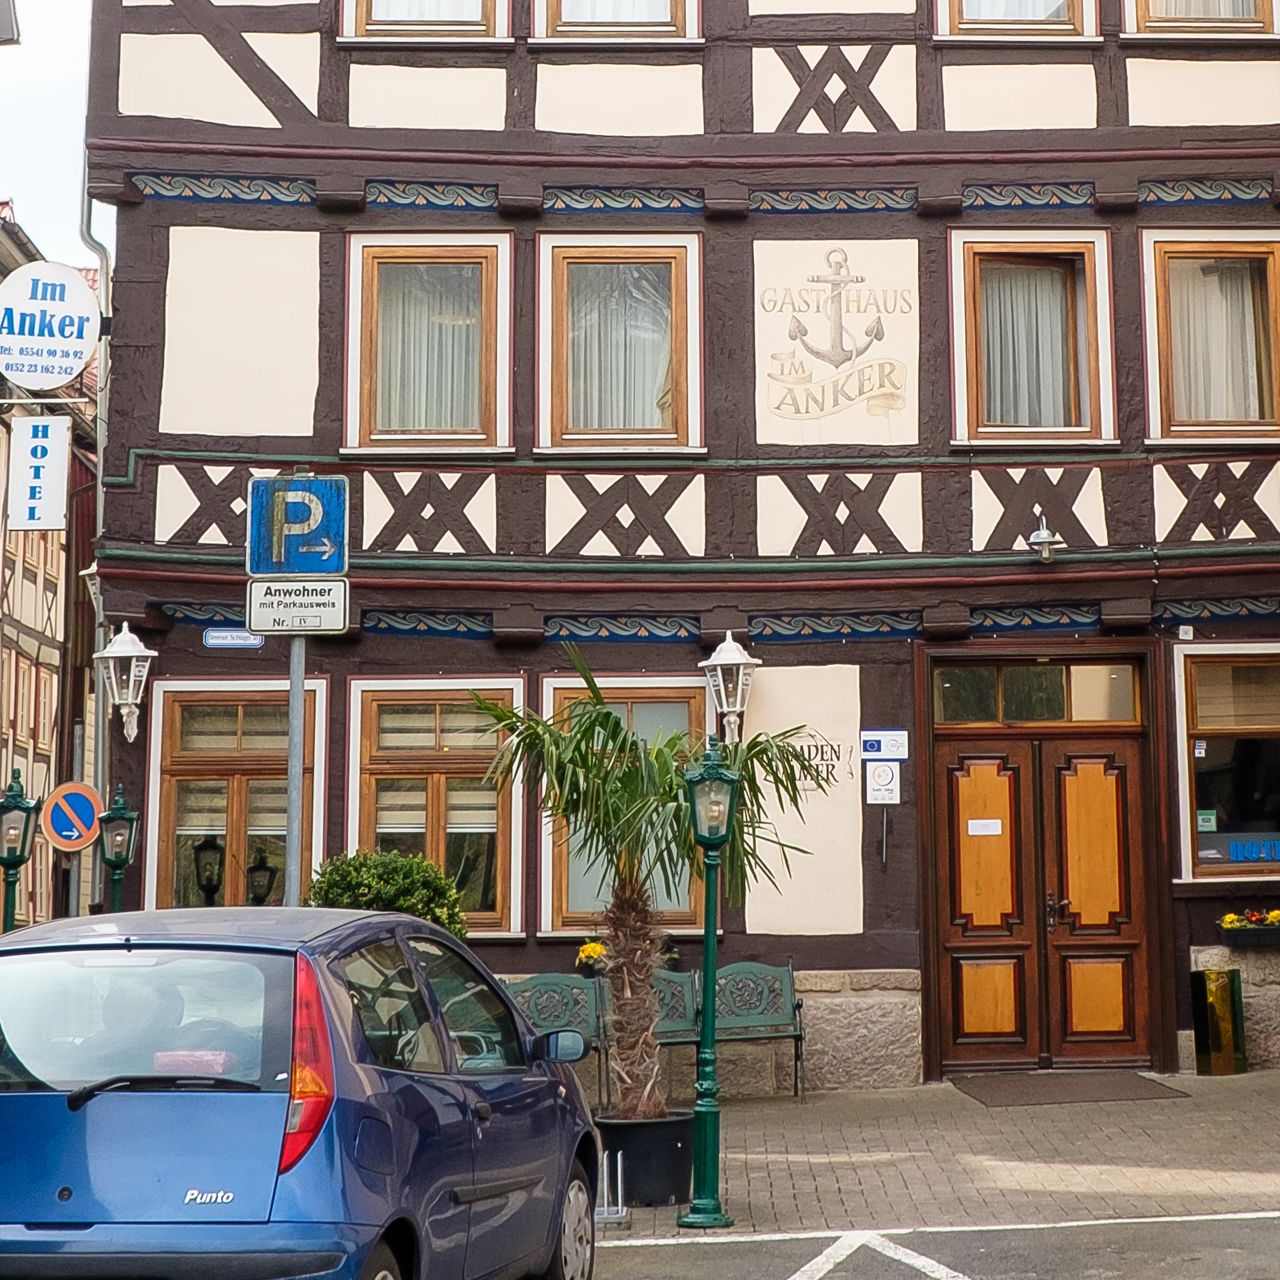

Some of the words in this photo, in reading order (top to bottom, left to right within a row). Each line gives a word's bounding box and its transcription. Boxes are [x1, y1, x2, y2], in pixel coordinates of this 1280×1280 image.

[28, 278, 66, 302] Im
[0, 346, 13, 356] Tel:
[19, 347, 43, 357] 05541
[47, 349, 57, 358] 90
[60, 350, 70, 359] 36
[73, 350, 83, 360] 92
[5, 362, 25, 372] 0152
[27, 364, 38, 373] 23
[40, 365, 55, 374] 162
[57, 366, 74, 376] 242
[779, 361, 806, 376] IM
[774, 362, 903, 415] ANKER
[27, 424, 50, 521] HOTEL
[272, 491, 324, 562] P
[264, 585, 333, 597] Anwohner
[259, 601, 274, 609] mit
[277, 600, 336, 609] Parkausweis
[273, 617, 289, 627] Nr.
[184, 1189, 234, 1205] Punto
